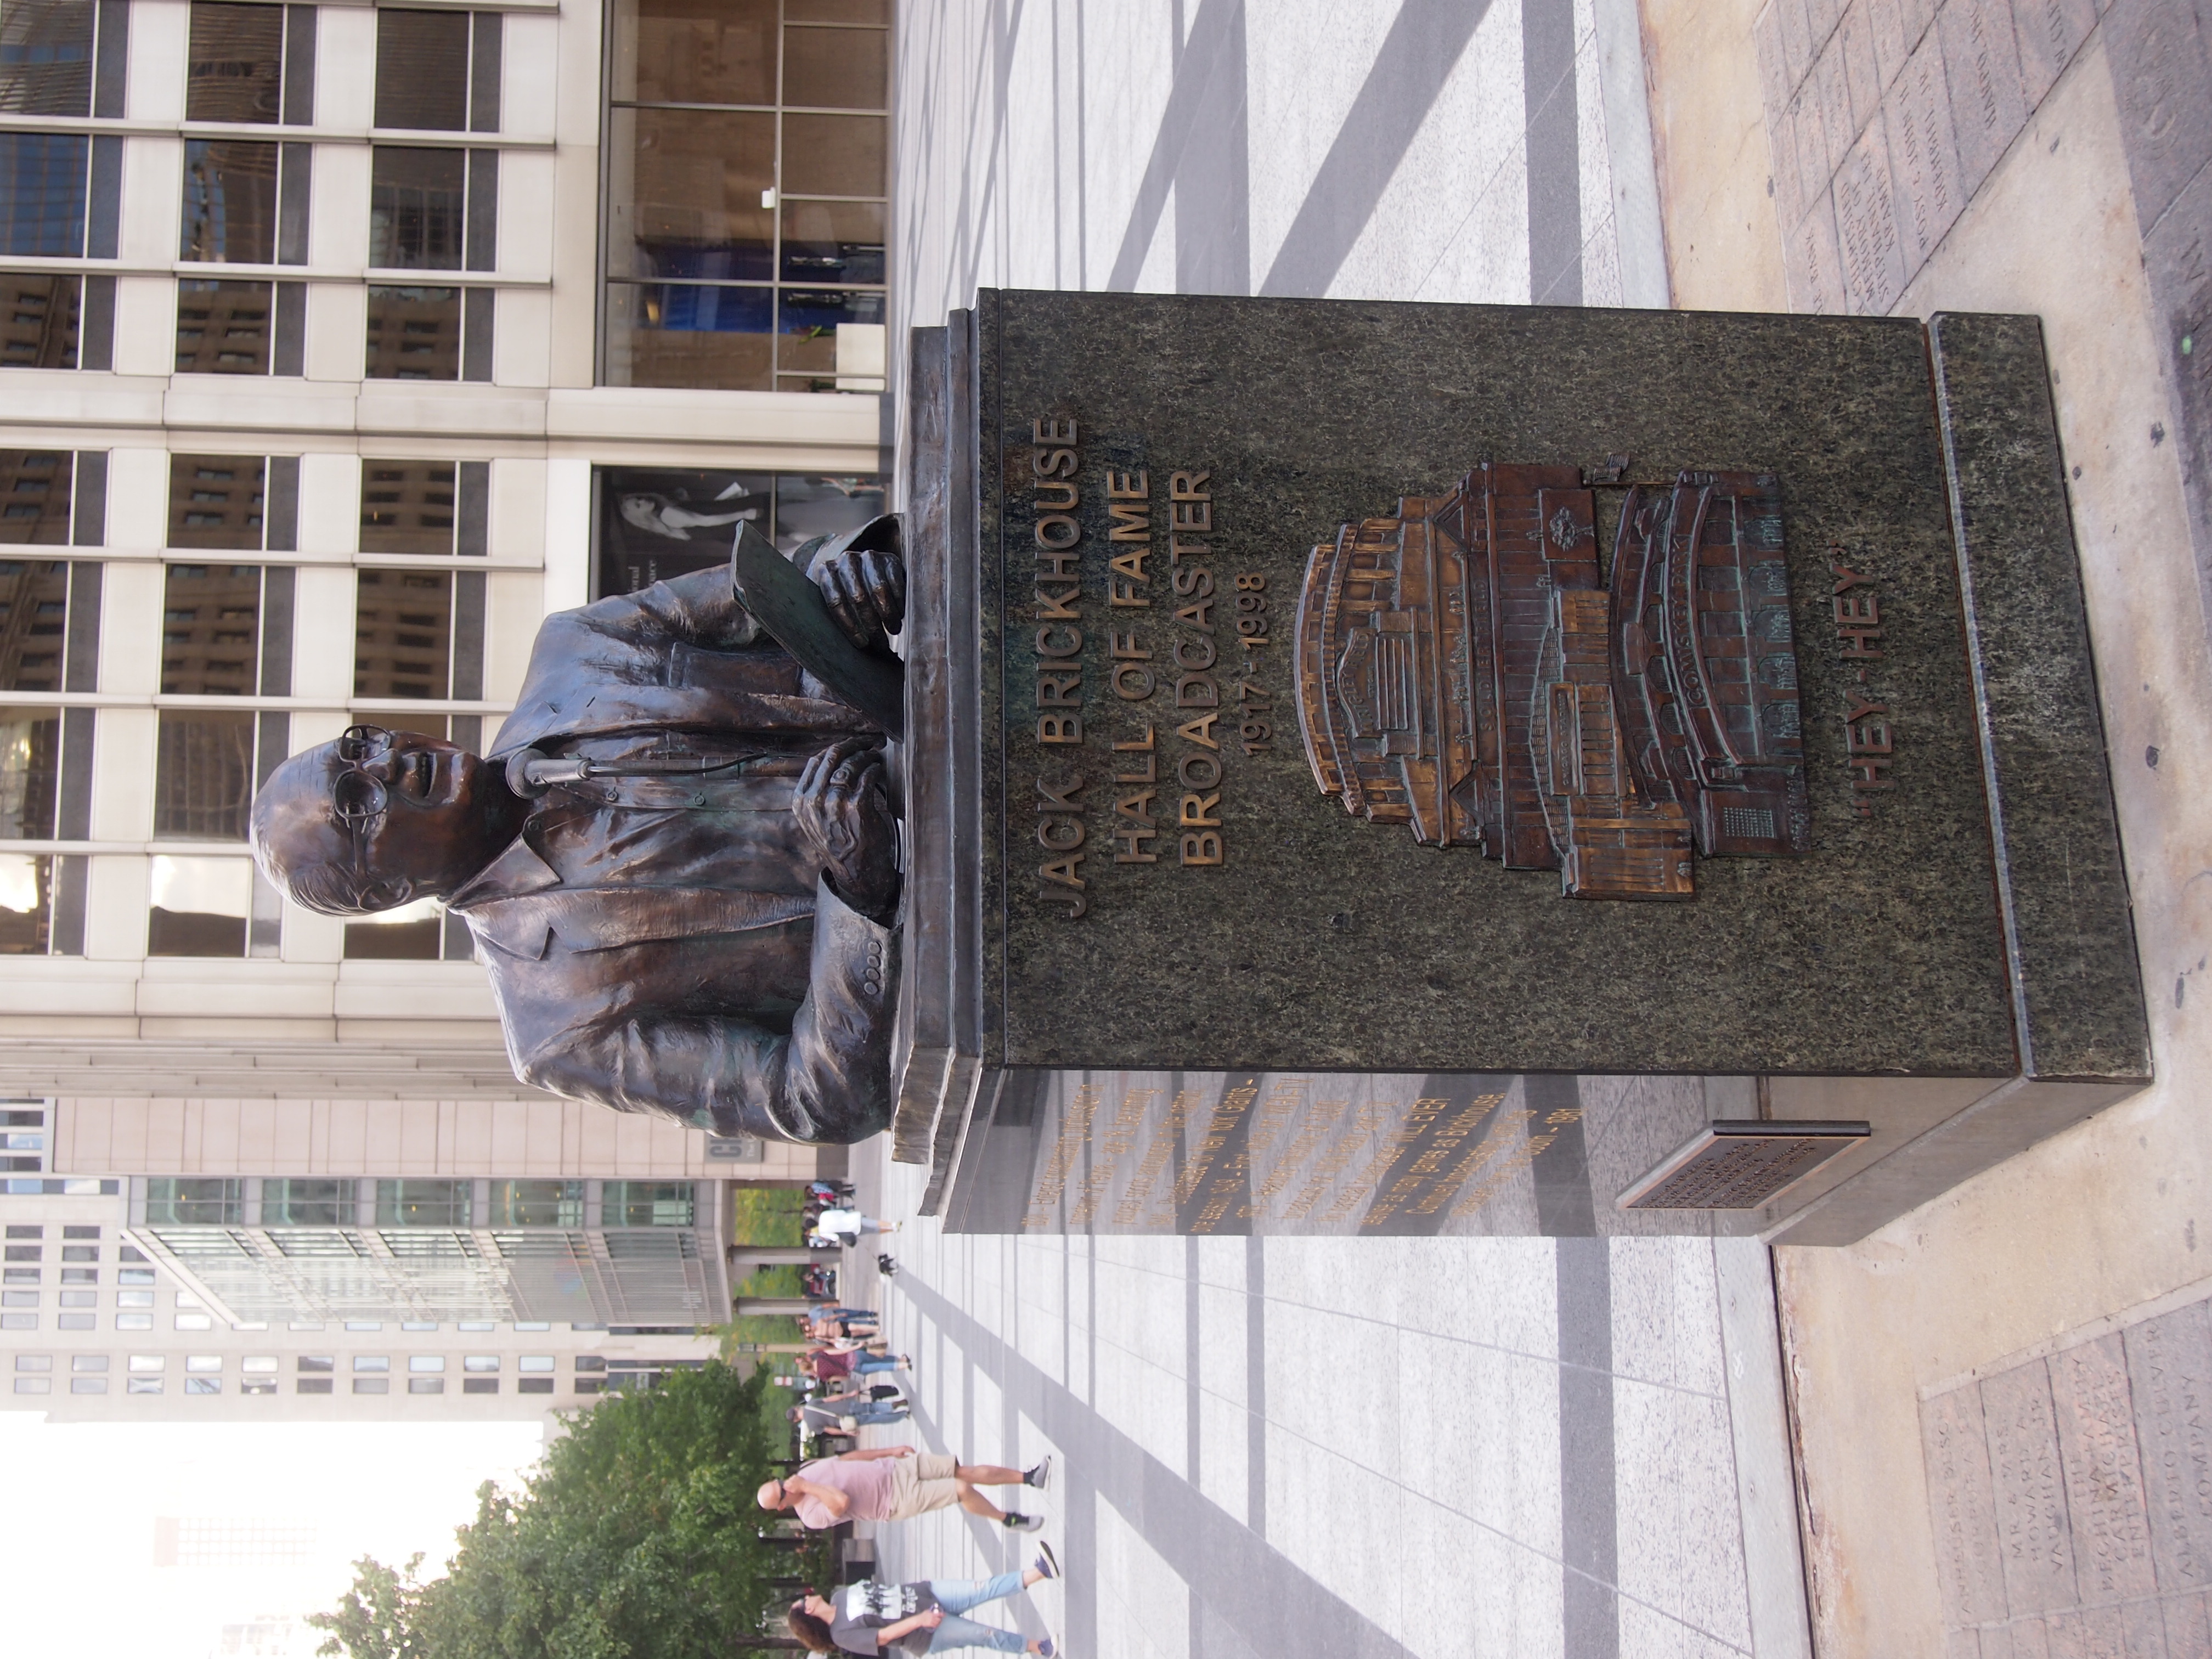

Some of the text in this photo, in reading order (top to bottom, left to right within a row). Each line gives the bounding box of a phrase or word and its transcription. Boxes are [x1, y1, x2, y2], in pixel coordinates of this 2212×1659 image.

[1898, 79, 1929, 249] POSY & JOHN H.
[1860, 145, 1889, 303] STEPHANIE LEE
[1876, 161, 1895, 252] KRAMER
[1805, 228, 1819, 283] BANK
[1839, 182, 1866, 315] N CHERISHED
[1851, 180, 1876, 302] MEMORY OF
[1234, 571, 1271, 651] 1998
[1671, 538, 1705, 706] COMISKEY PARK
[1032, 418, 1087, 918] JACK BRICKHOUSE
[1106, 470, 1157, 863] HALL OF FAME
[1170, 470, 1224, 866] BROADCASTER
[1474, 580, 1495, 731] SOLDIER FIELD
[1342, 632, 1374, 735] WRIGLEY FIELD
[1239, 682, 1272, 757] 1917
[1105, 1088, 1164, 1126] becoming
[1210, 1087, 1258, 1113] Giants
[1401, 1098, 1451, 1121] EVER
[1434, 1092, 1508, 1136] Brickhouse.
[1187, 1136, 1227, 1151] New
[1197, 1116, 1240, 1131] York
[1239, 1132, 1277, 1150] voice
[1259, 1119, 1284, 1128] on
[1383, 1124, 1427, 1142] WILL
[1431, 1138, 1460, 1148] as
[1029, 1182, 1065, 1205] Entered
[1058, 1094, 1101, 1133] profession
[1100, 1142, 1135, 1154] age
[1136, 1141, 1176, 1175] announcer
[1179, 1154, 1215, 1163] for
[1222, 1154, 1262, 1169] First
[1353, 1146, 1408, 1184] broadcaster
[1408, 1150, 1451, 1173] games
[1511, 1134, 1558, 1155] booth
[1079, 1165, 1117, 1184] Peoria
[1125, 1178, 1158, 1197] sports
[1156, 1166, 1208, 1204] Broadcasted
[1391, 1175, 1434, 1192] many
[1405, 1184, 1459, 1214] Continued
[1433, 1140, 1514, 1182] broadcasting
[1111, 1200, 1146, 1224] youngest
[1276, 1186, 1326, 1218] broadcasts
[1330, 1186, 1370, 1211] baseball
[1381, 1194, 1407, 1203] as
[1189, 1221, 1216, 1232] one
[2072, 1357, 2095, 1453] FAMILY
[2108, 1369, 2145, 1559] ENTERPRISES
[2146, 1322, 2194, 1577] ALBERTO CULVER
[2181, 1374, 2212, 1516] COMPANY
[2070, 1449, 2085, 1504] THE
[2093, 1380, 2128, 1562] CARMICHAEL
[1937, 1409, 1972, 1614] ANHEUSER BUSCH
[2018, 1448, 2042, 1562] HOWARD
